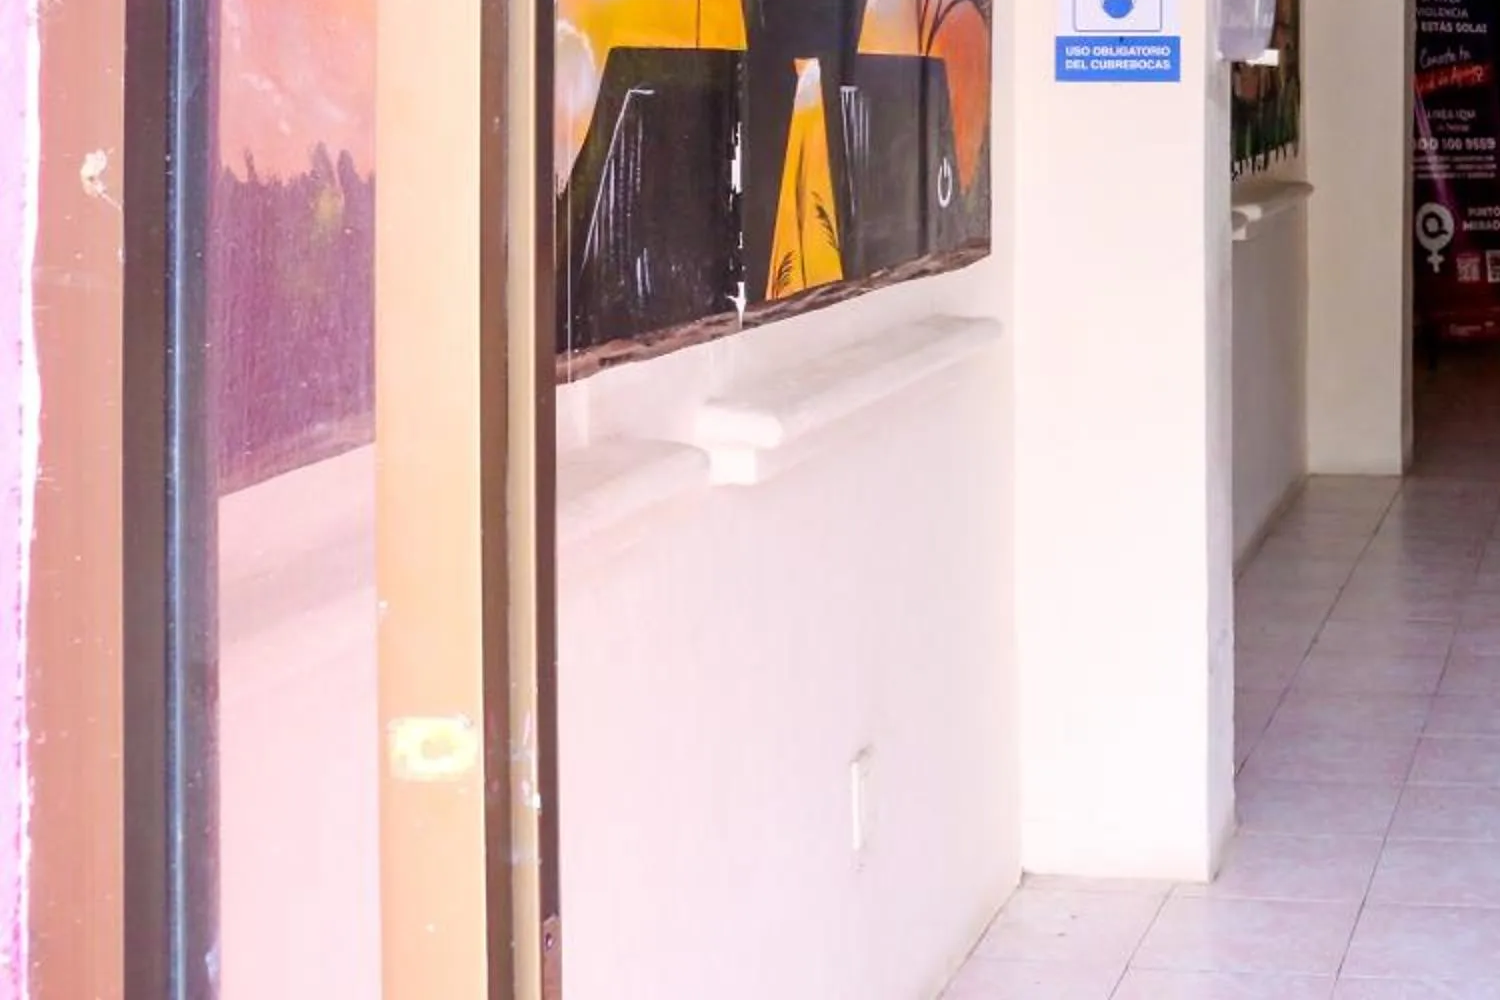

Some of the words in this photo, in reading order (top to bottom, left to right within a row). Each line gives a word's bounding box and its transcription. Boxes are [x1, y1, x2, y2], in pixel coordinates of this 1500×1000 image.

[1065, 45, 1090, 57] USO
[1093, 45, 1171, 57] OBLIGATORIO
[1065, 59, 1088, 71] DEL
[1090, 59, 1172, 71] CUBREBOCAS
